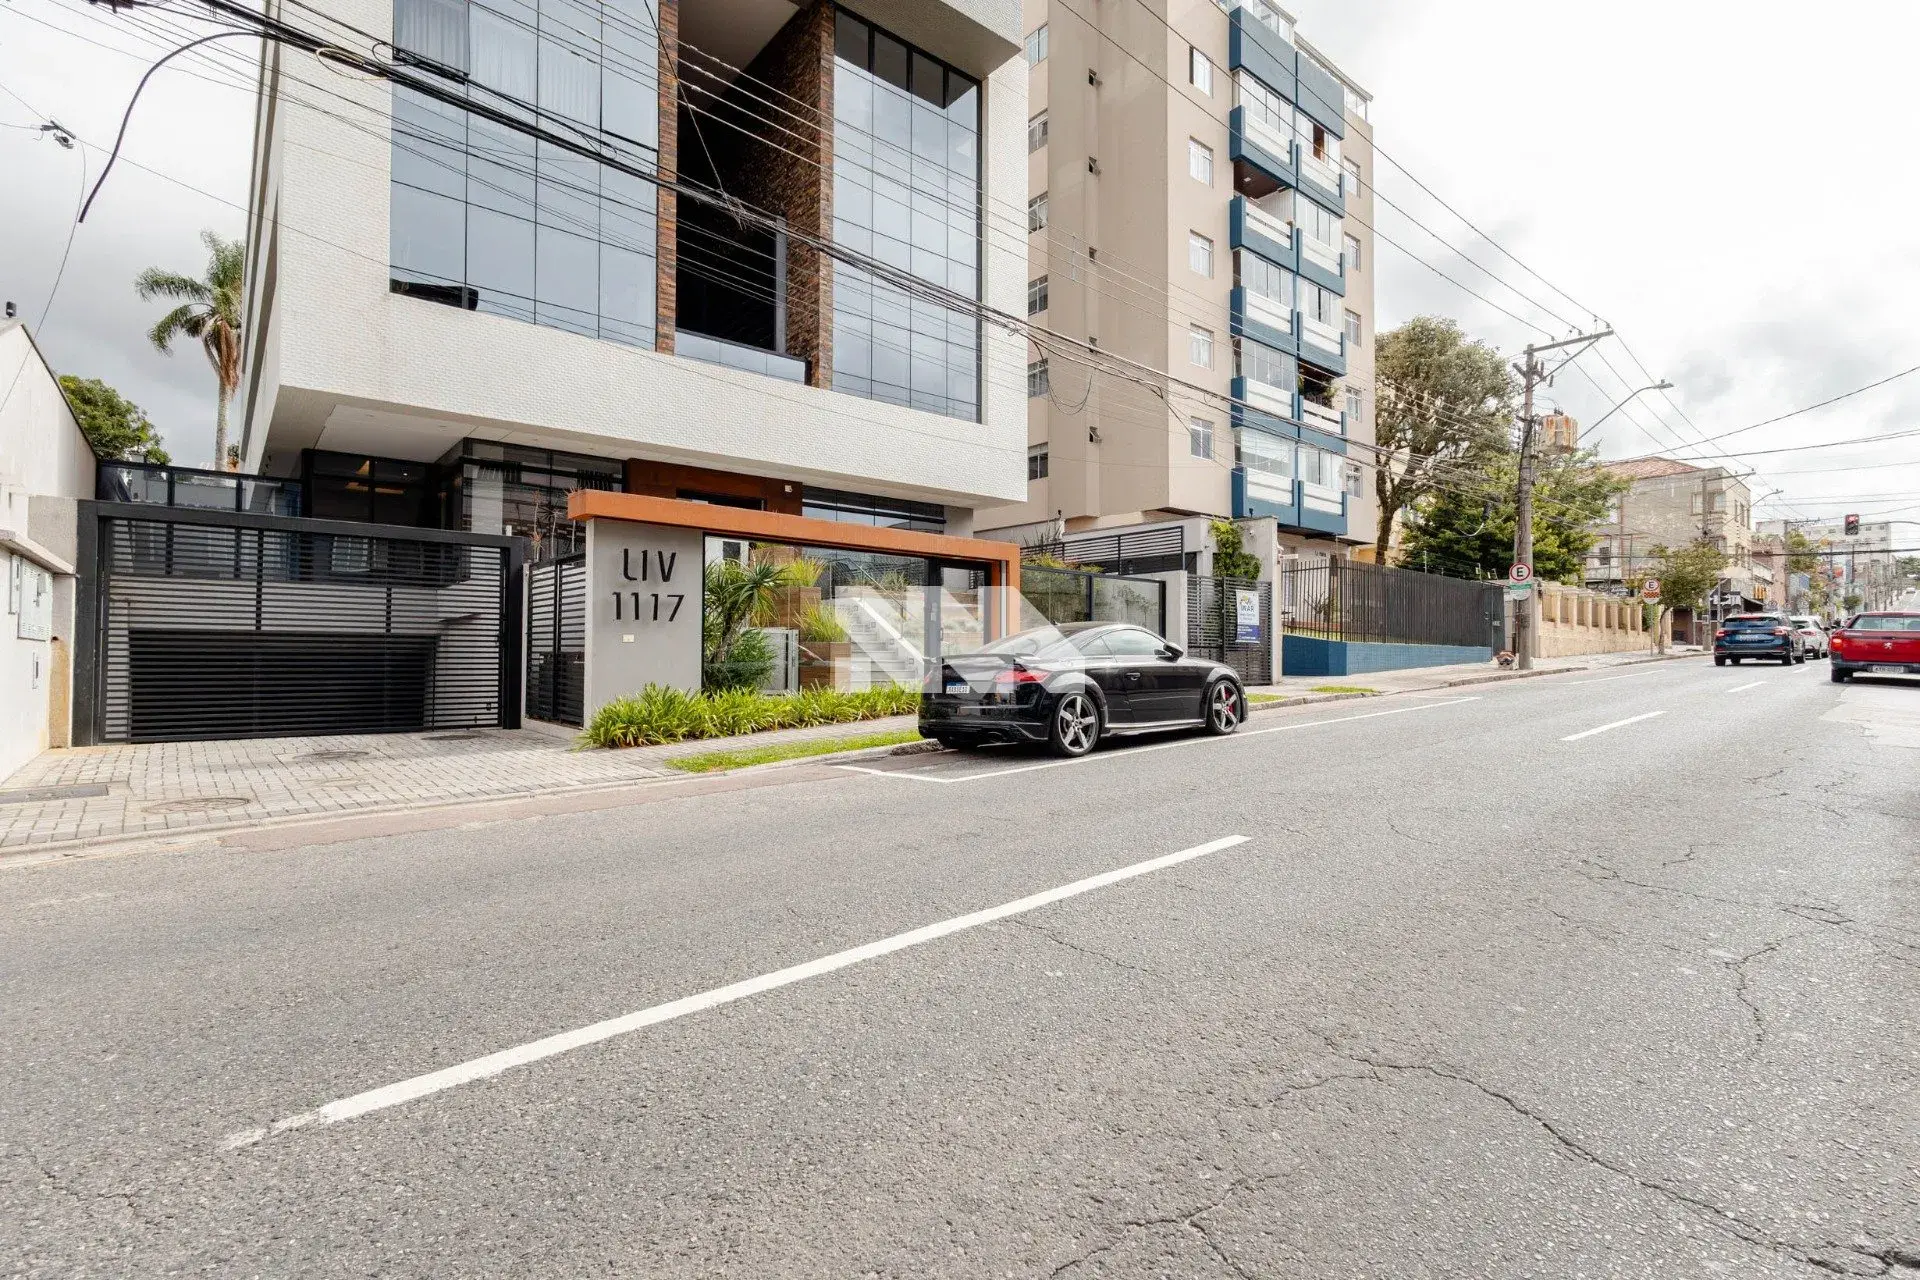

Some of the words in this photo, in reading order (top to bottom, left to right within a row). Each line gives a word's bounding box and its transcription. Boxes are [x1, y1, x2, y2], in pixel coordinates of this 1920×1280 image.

[623, 548, 676, 582] LIV
[1516, 567, 1524, 577] E
[612, 592, 684, 622] 1117
